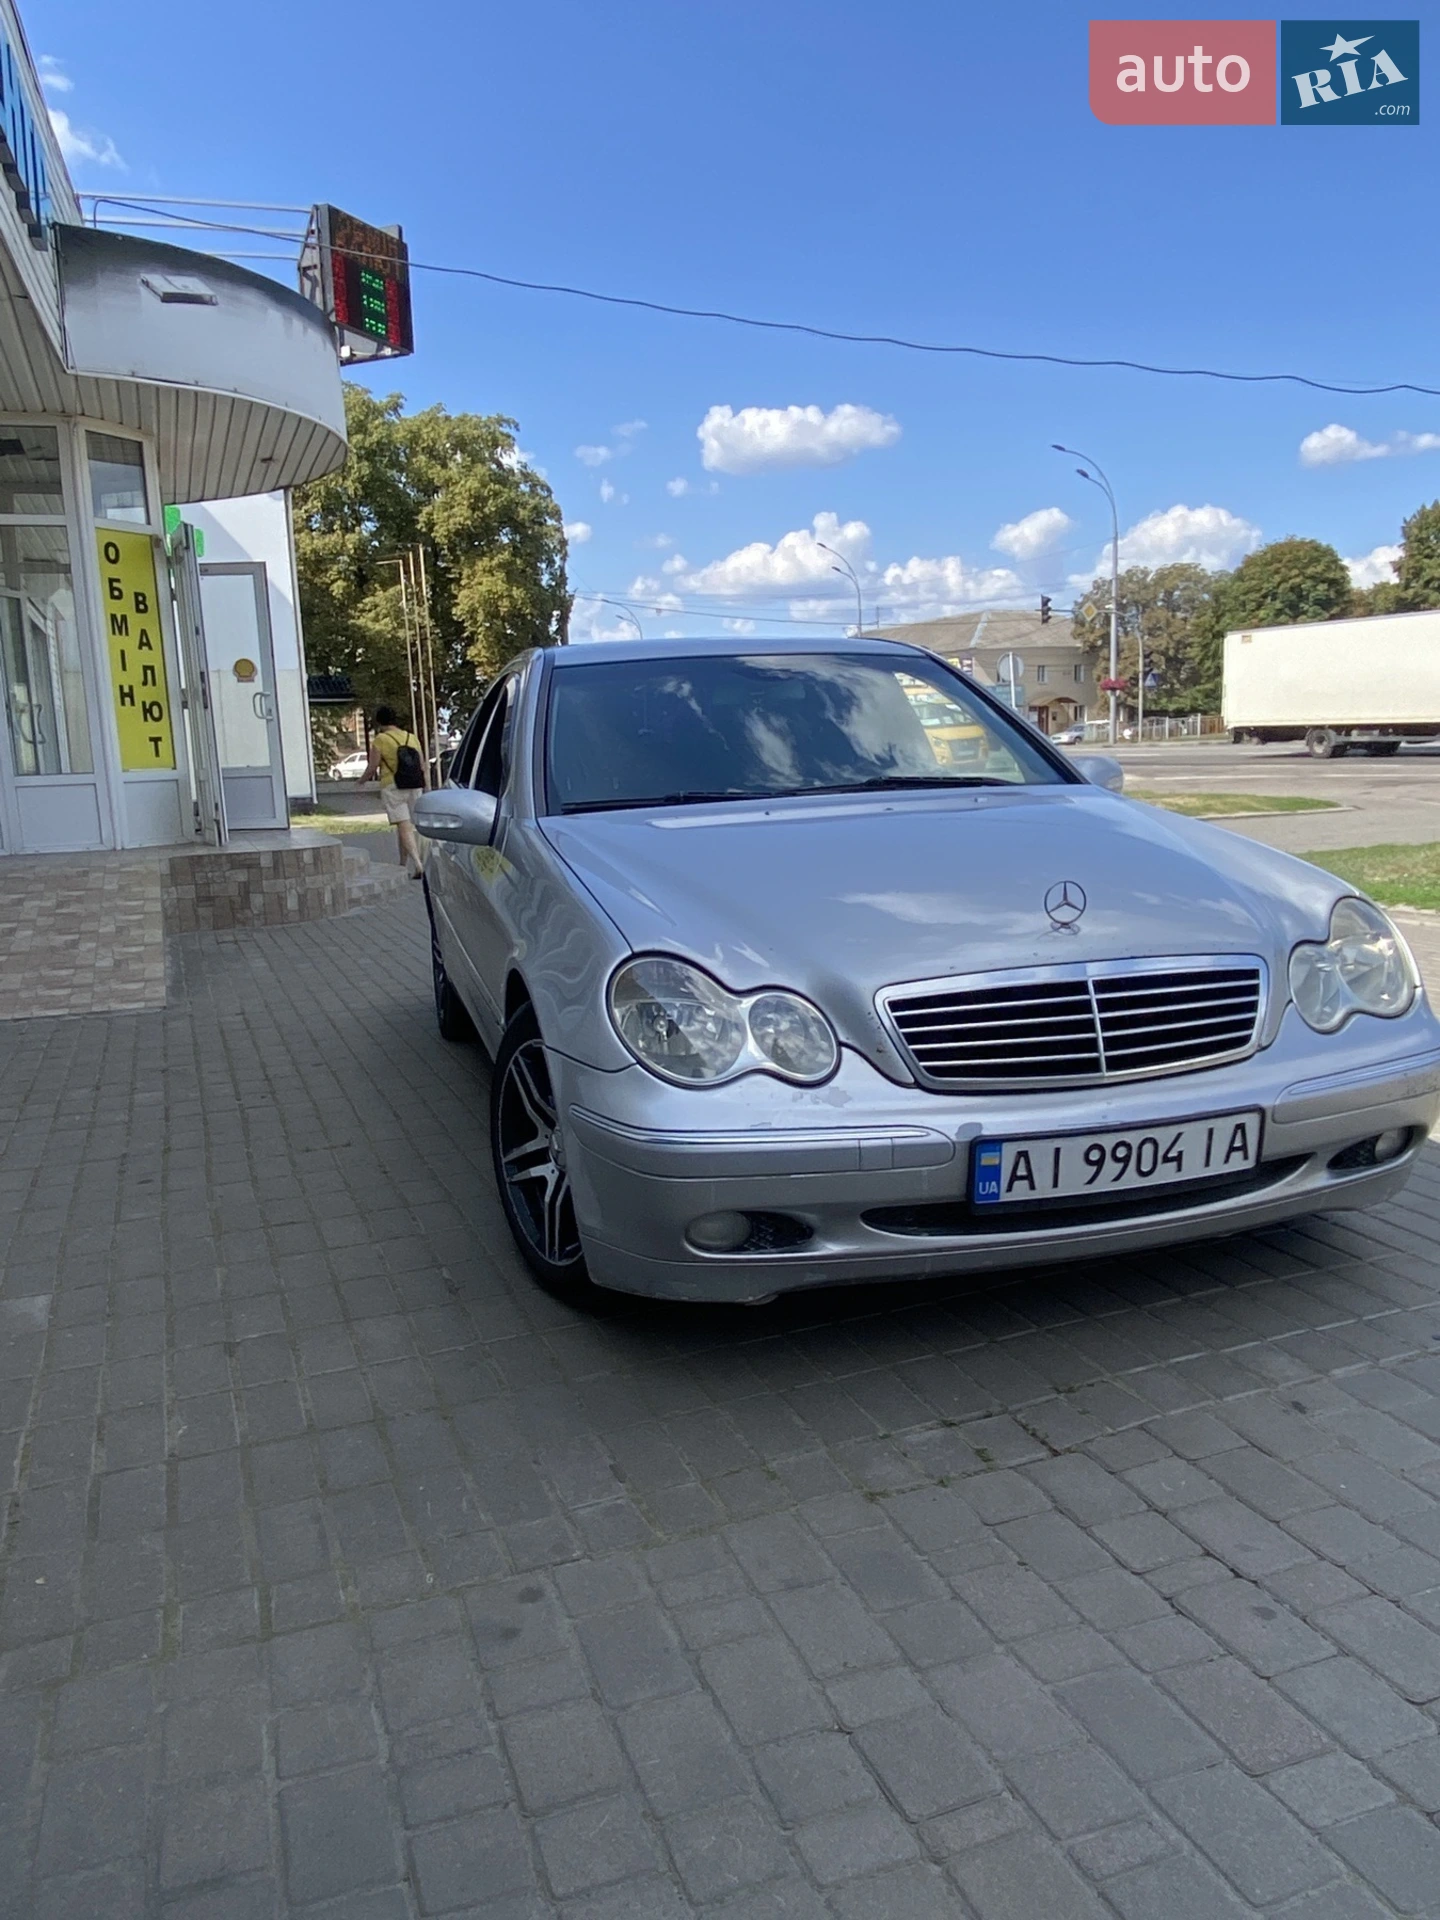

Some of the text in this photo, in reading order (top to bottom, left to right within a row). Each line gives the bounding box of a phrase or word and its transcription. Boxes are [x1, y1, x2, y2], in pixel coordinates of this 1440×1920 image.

[104, 541, 135, 707] ОБМІН
[133, 592, 163, 757] ВАЛЮТ
[978, 1181, 998, 1194] UA
[1005, 1122, 1249, 1193] AI 9904 IA
